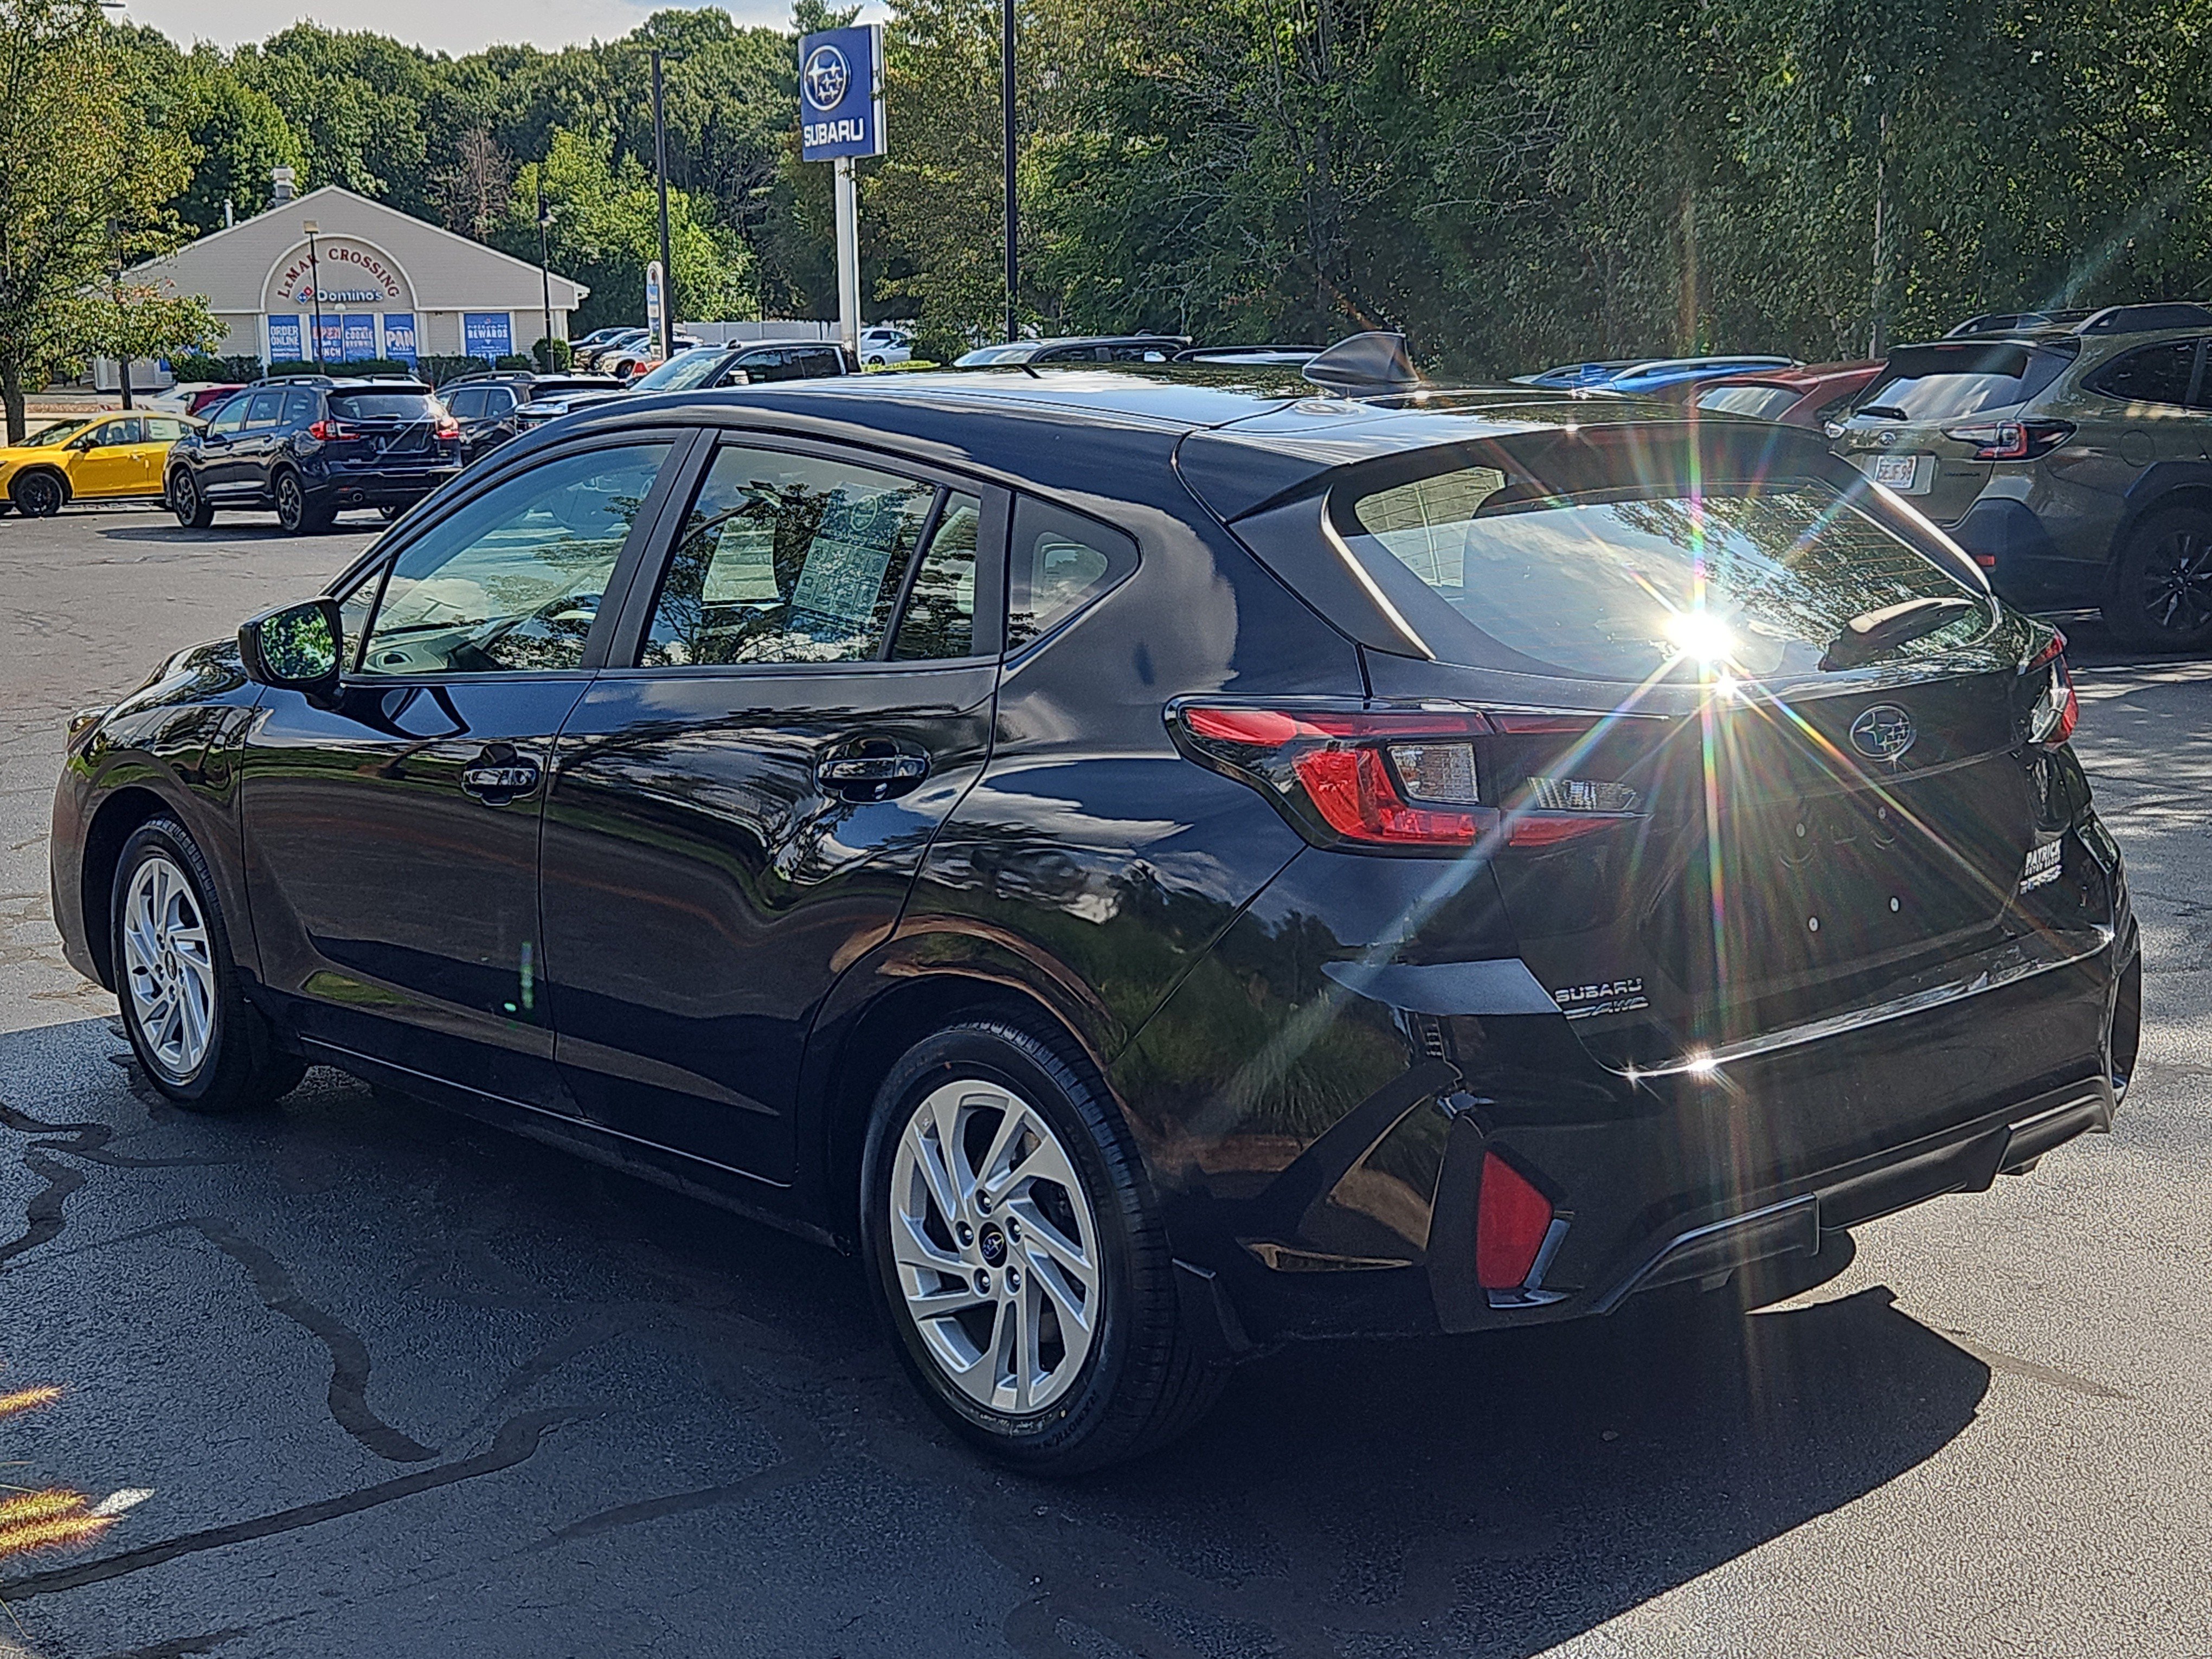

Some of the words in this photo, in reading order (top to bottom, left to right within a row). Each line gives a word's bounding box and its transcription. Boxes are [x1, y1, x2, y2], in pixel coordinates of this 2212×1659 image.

[804, 118, 864, 147] SUBARU
[329, 248, 400, 298] CROSSING
[317, 288, 384, 302] Domino's
[270, 326, 299, 336] ORDER
[385, 330, 415, 348] PAN
[467, 329, 508, 339] REWARDS
[271, 336, 299, 346] ONLINE
[2025, 838, 2062, 869] PATRICK
[1555, 978, 1643, 1003] SUBARU
[1591, 996, 1649, 1017] AWD
